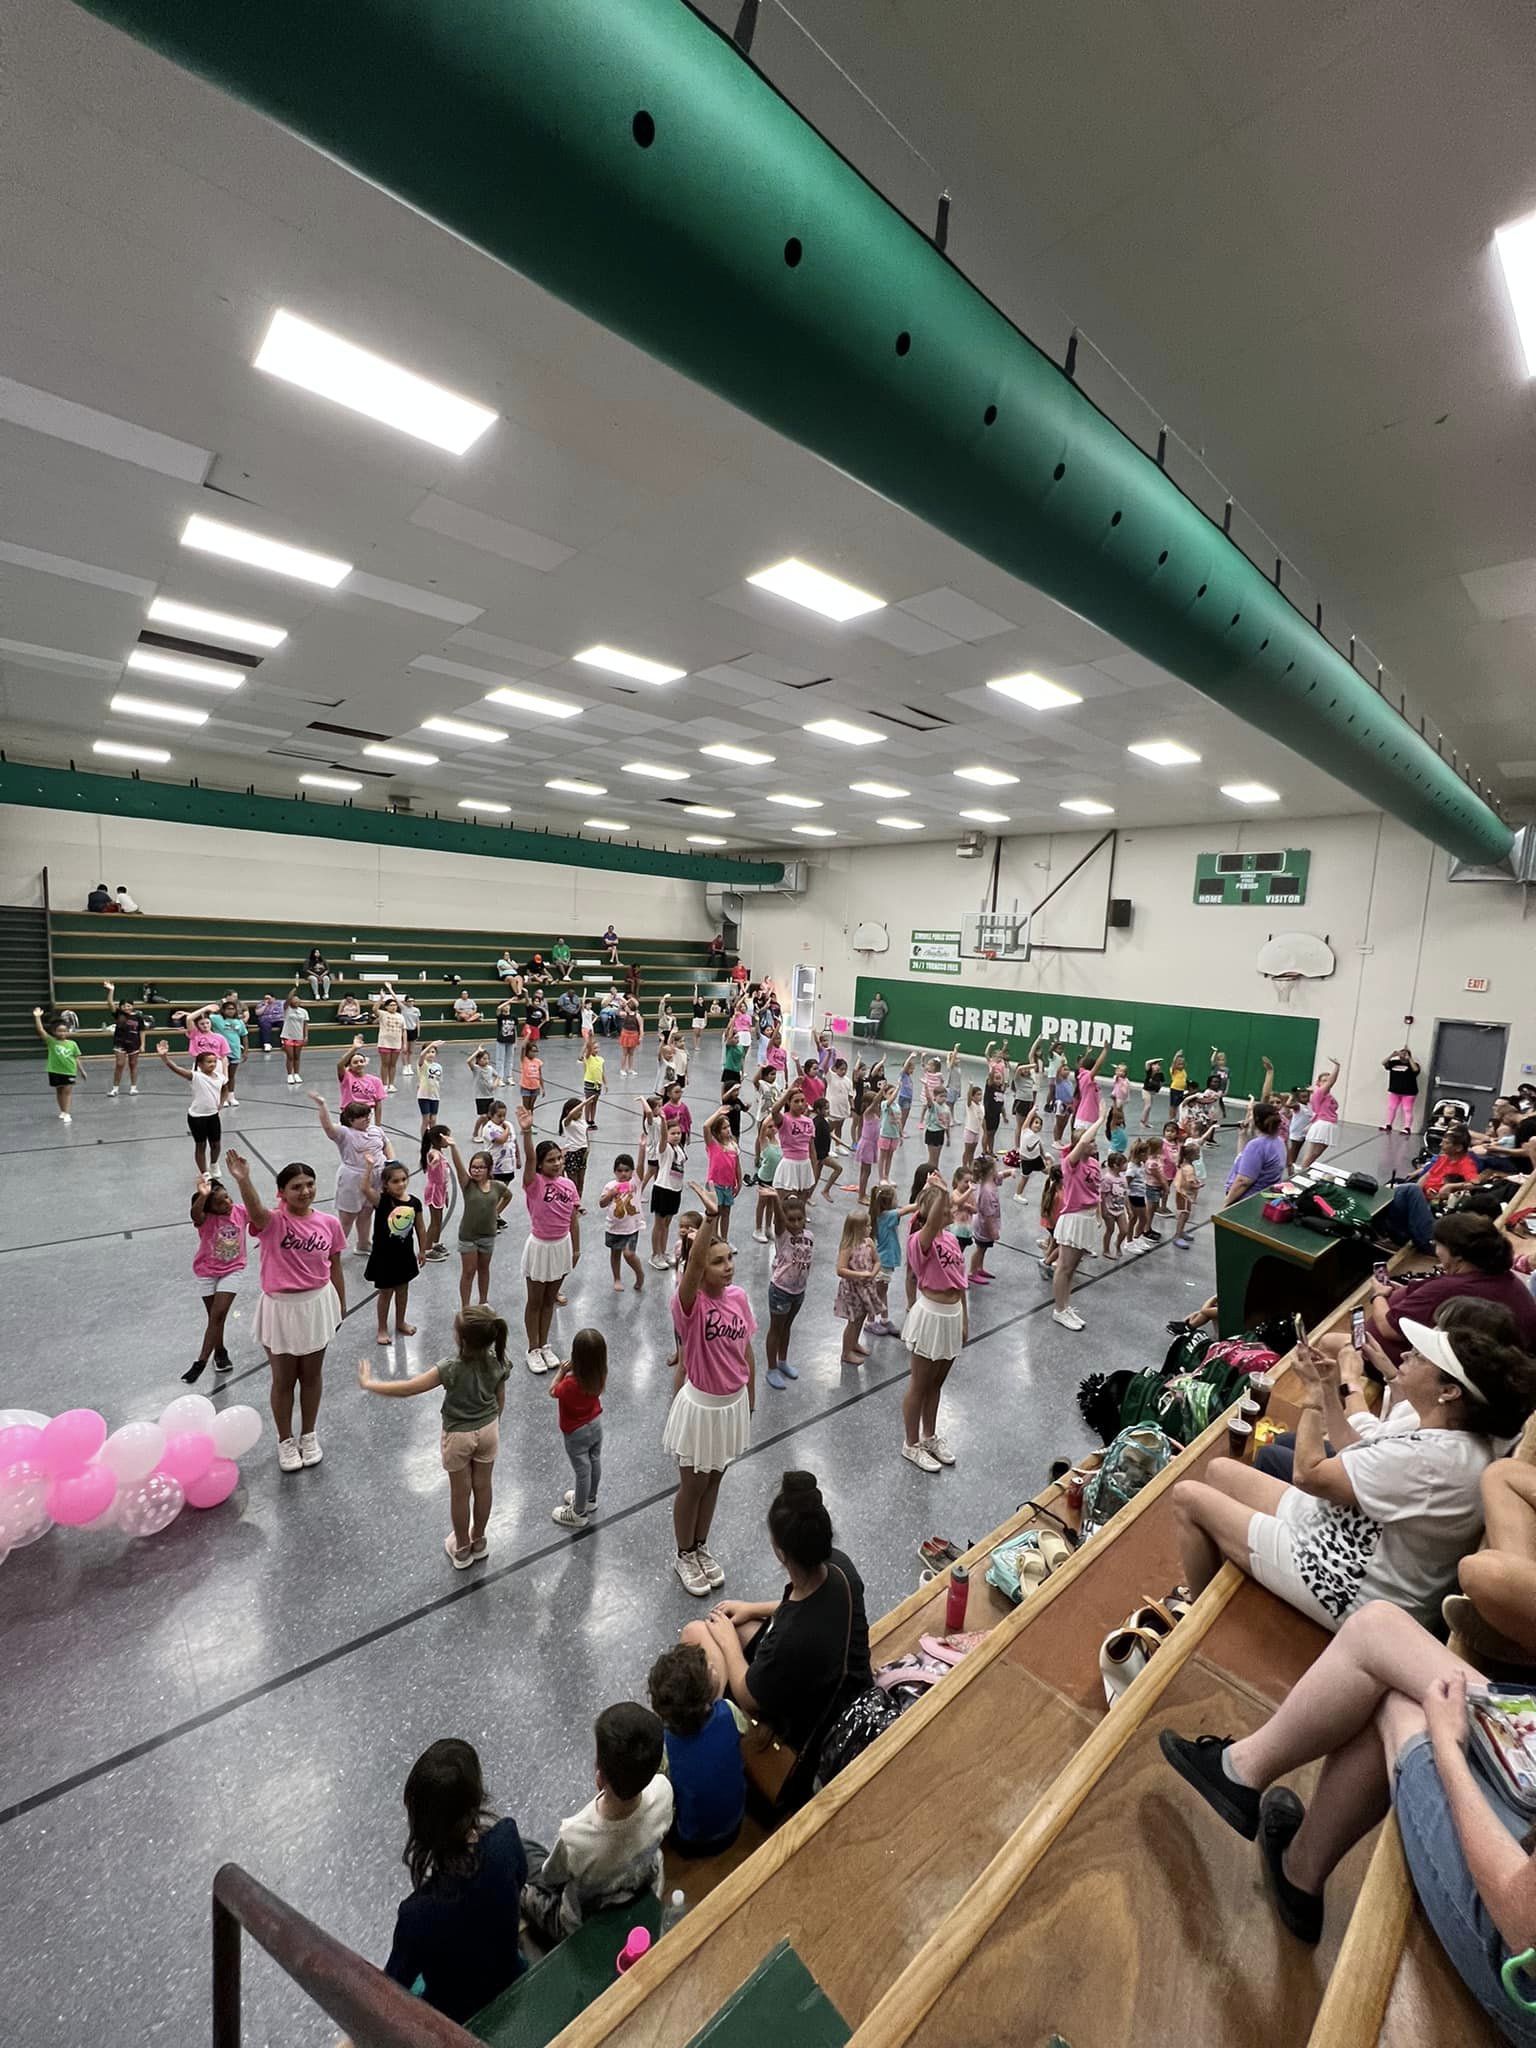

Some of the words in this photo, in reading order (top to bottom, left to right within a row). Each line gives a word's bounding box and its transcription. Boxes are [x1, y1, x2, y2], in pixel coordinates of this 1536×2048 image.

[1198, 894, 1223, 904] HOME
[1265, 894, 1301, 904] VISITOR
[1467, 978, 1485, 989] EXIT
[949, 1005, 1033, 1038] GREEN
[1041, 1016, 1134, 1051] PRIDE
[280, 1227, 330, 1253] Barbie
